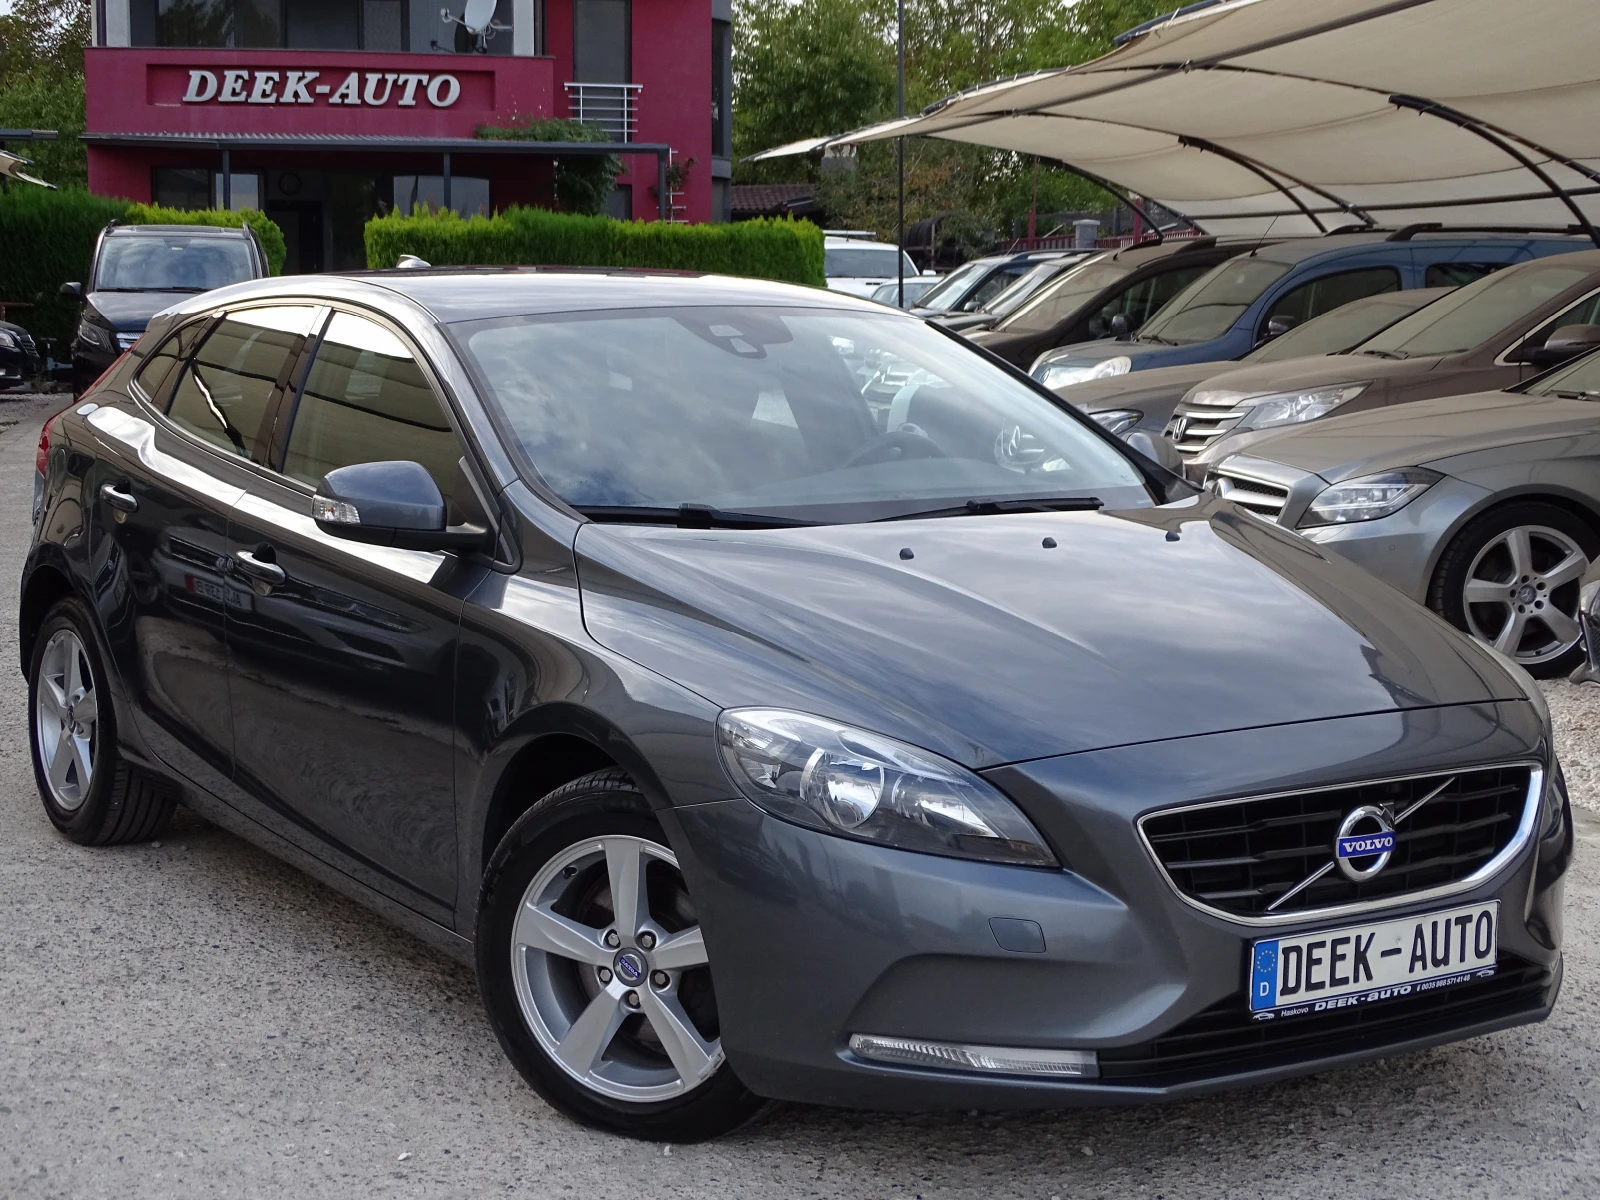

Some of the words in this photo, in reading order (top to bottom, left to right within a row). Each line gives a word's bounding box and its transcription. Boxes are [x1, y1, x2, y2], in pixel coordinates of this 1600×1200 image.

[183, 70, 461, 107] DEEK-AUTO
[1342, 836, 1393, 853] VOLVO
[1259, 981, 1270, 997] D
[1281, 1005, 1309, 1017] Haskovo
